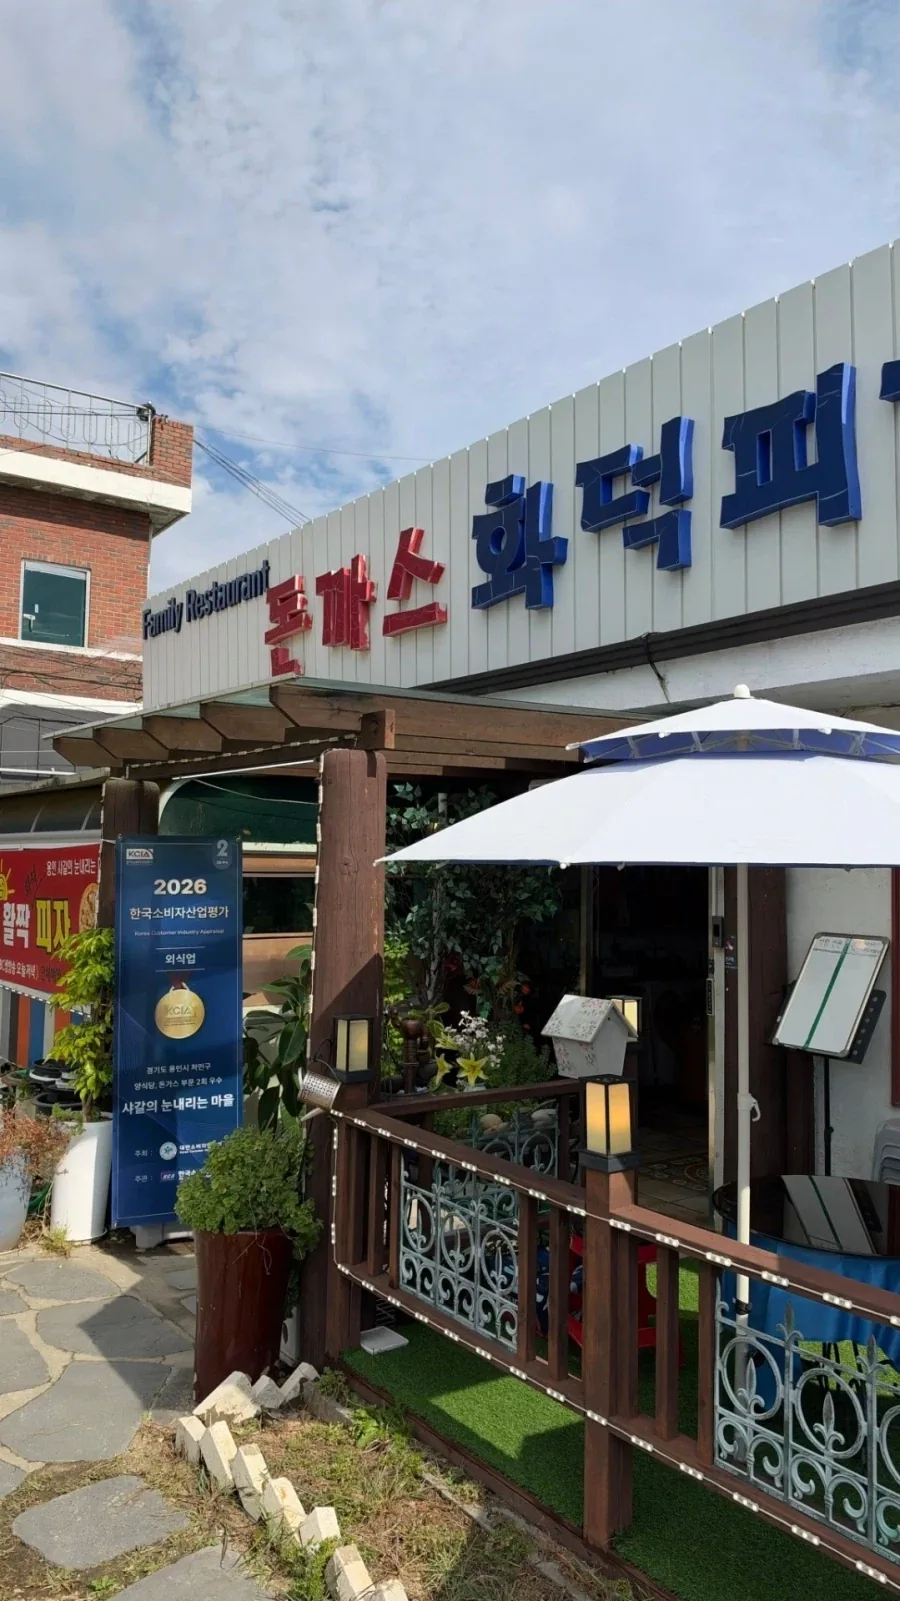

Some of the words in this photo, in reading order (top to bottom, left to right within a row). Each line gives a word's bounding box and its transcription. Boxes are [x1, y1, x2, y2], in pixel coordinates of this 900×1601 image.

[264, 527, 447, 677] 돈까스
[472, 360, 900, 610] 화덕피
[142, 597, 183, 640] Family
[186, 560, 270, 622] Restaurant
[128, 850, 150, 858] KCIA
[216, 839, 228, 857] 2
[46, 860, 57, 876] 용인
[74, 858, 96, 875] 눈내리는
[153, 878, 207, 895] 2026
[129, 906, 230, 920] 한국소비자산업평가
[3, 902, 30, 948] 활짝
[36, 899, 71, 953] 피자
[177, 928, 199, 936] Industry
[165, 953, 196, 965] 외식업
[146, 1066, 167, 1075] 경기도
[168, 1064, 189, 1073] 용인시
[191, 1062, 211, 1072] 처인구
[158, 1080, 179, 1089] 돈가스
[181, 1078, 194, 1087] 부문
[209, 1076, 222, 1085] 우수
[121, 1100, 158, 1115] 샤갈의
[161, 1096, 208, 1112] 눈내리는
[211, 1093, 234, 1108] 마을
